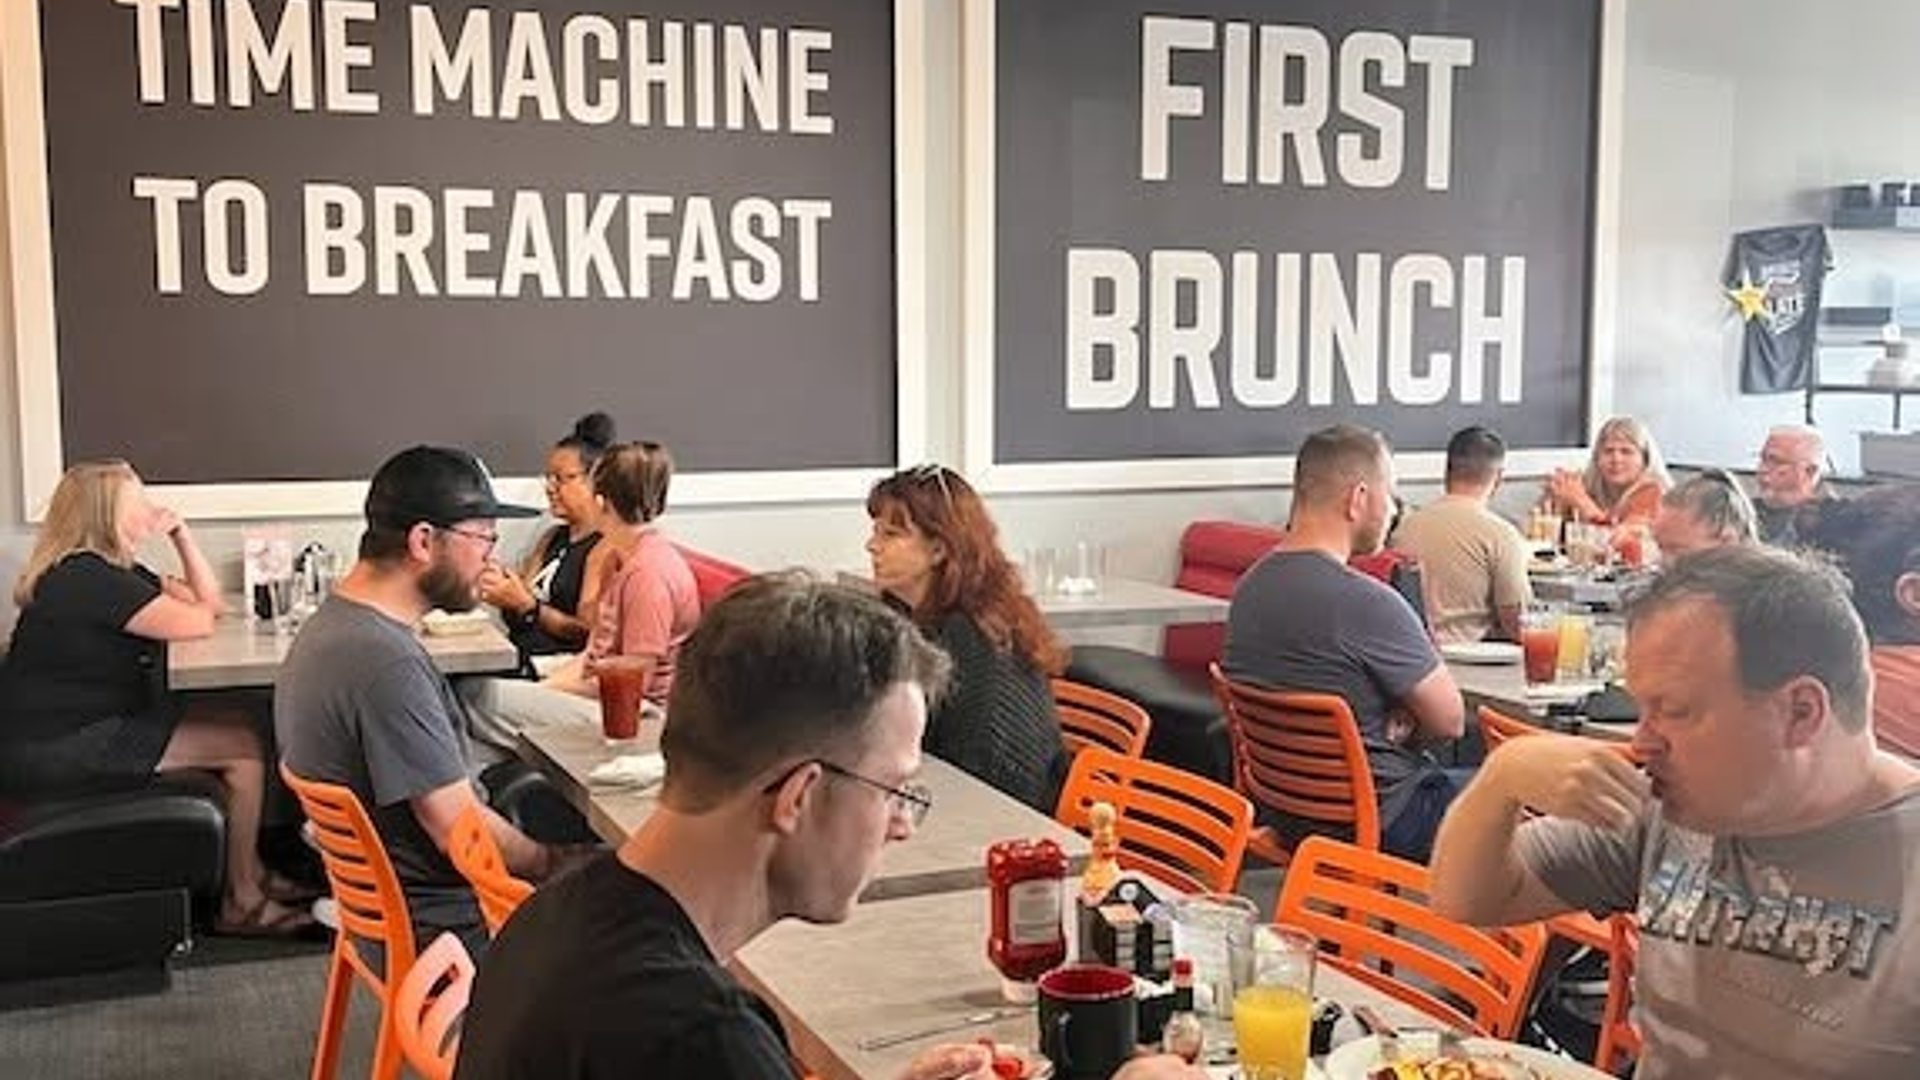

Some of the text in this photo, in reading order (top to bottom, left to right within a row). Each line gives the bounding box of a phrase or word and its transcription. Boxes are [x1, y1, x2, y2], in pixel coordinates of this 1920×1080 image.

[116, 0, 834, 135] TIME MACHINE
[1141, 17, 1474, 191] FIRST
[133, 177, 832, 303] TO BREAKFAST
[1065, 248, 1527, 410] BRUNCH
